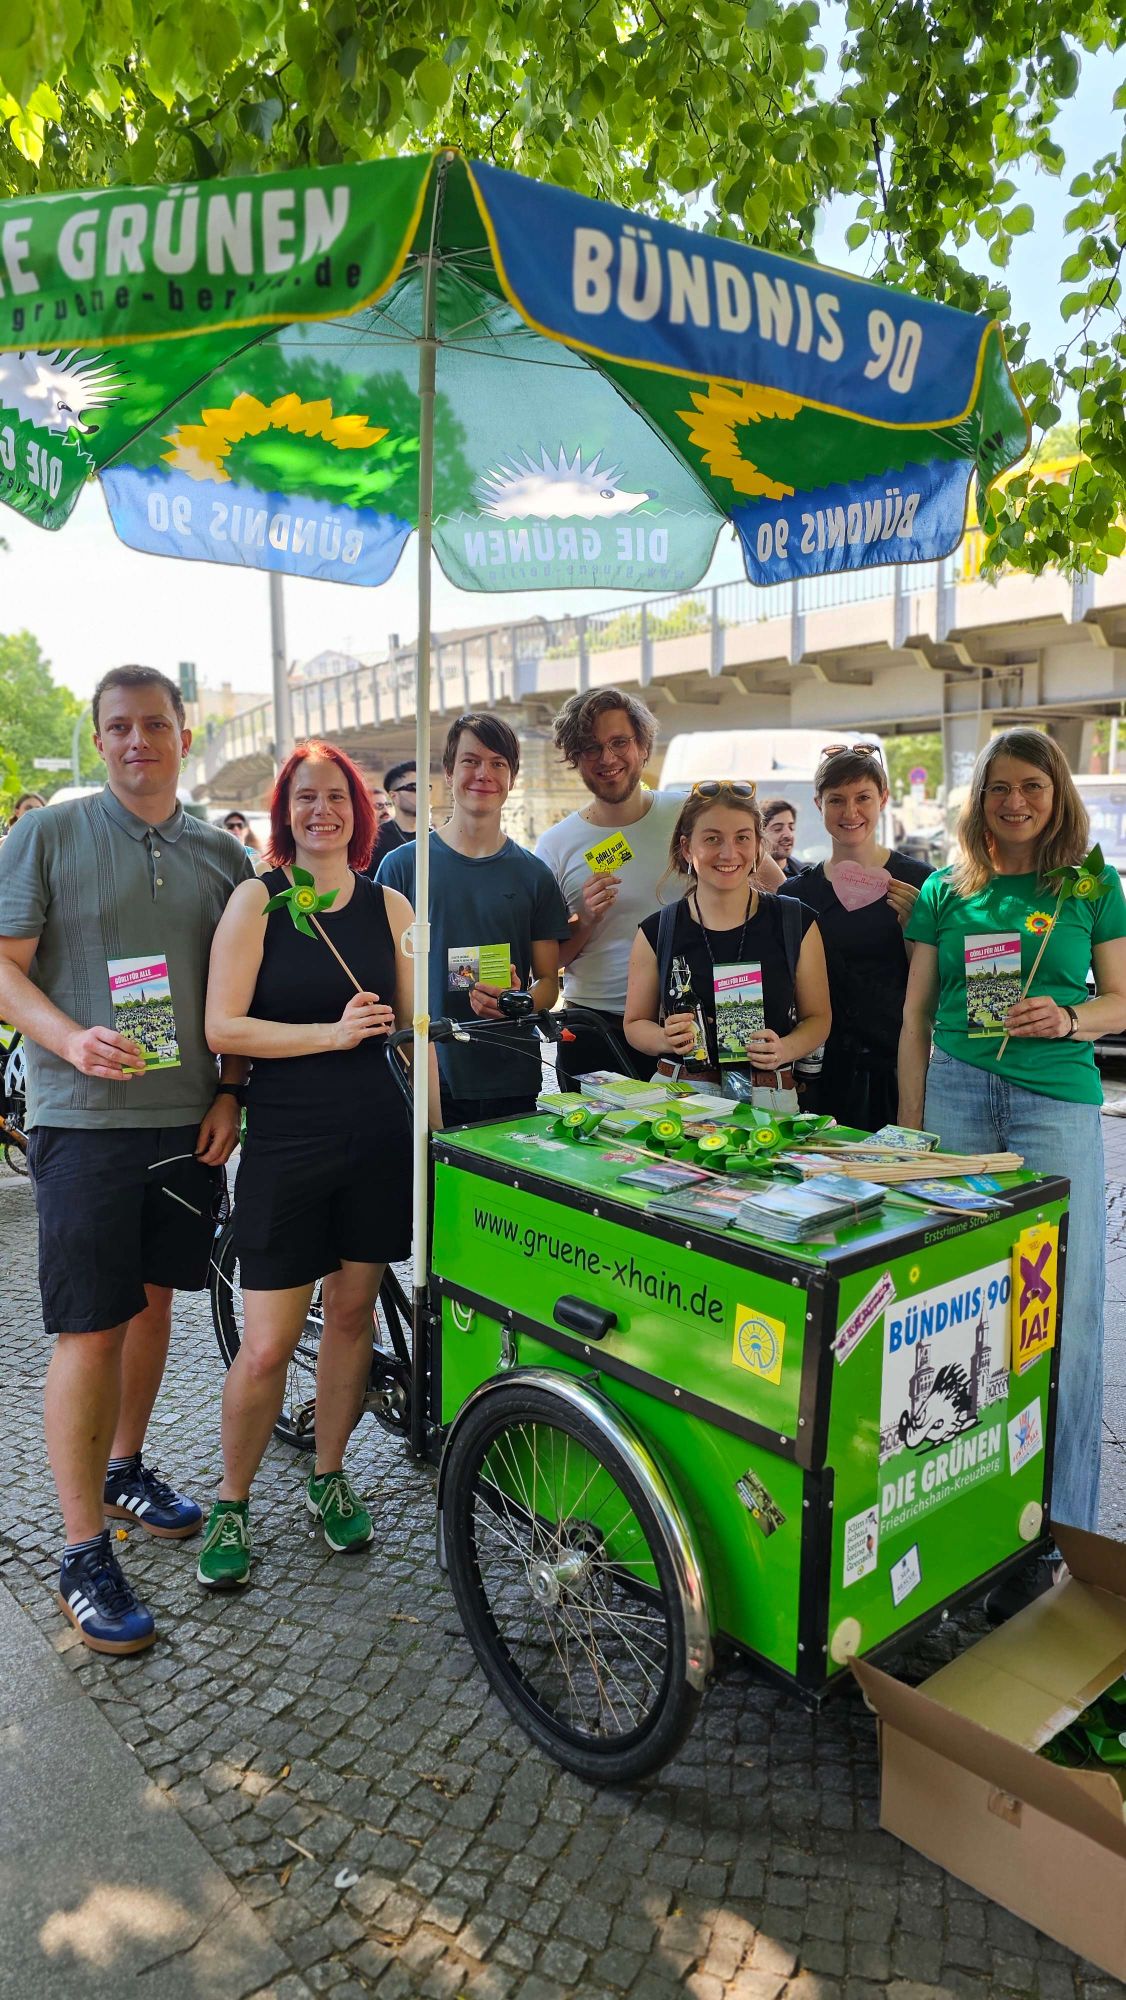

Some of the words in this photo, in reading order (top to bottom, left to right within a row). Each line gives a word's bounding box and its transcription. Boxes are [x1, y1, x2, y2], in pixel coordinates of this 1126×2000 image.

[0, 217, 40, 297] E
[58, 186, 350, 281] GRÜNEN
[572, 224, 844, 362] BÜNDNIS
[863, 308, 923, 394] 90
[129, 971, 139, 981] FÜR
[140, 969, 152, 978] ALLE
[984, 947, 993, 955] FÜR
[474, 1207, 724, 1324] www.gruene-xhain.de
[889, 1286, 982, 1354] BÜNDNIS
[987, 1275, 1011, 1311] 90
[1020, 1306, 1050, 1353] JA!
[879, 1457, 1001, 1535] Friedrichshain-Kreuzberg
[881, 1469, 916, 1518] DIE
[921, 1424, 1001, 1493] GRÜNEN
